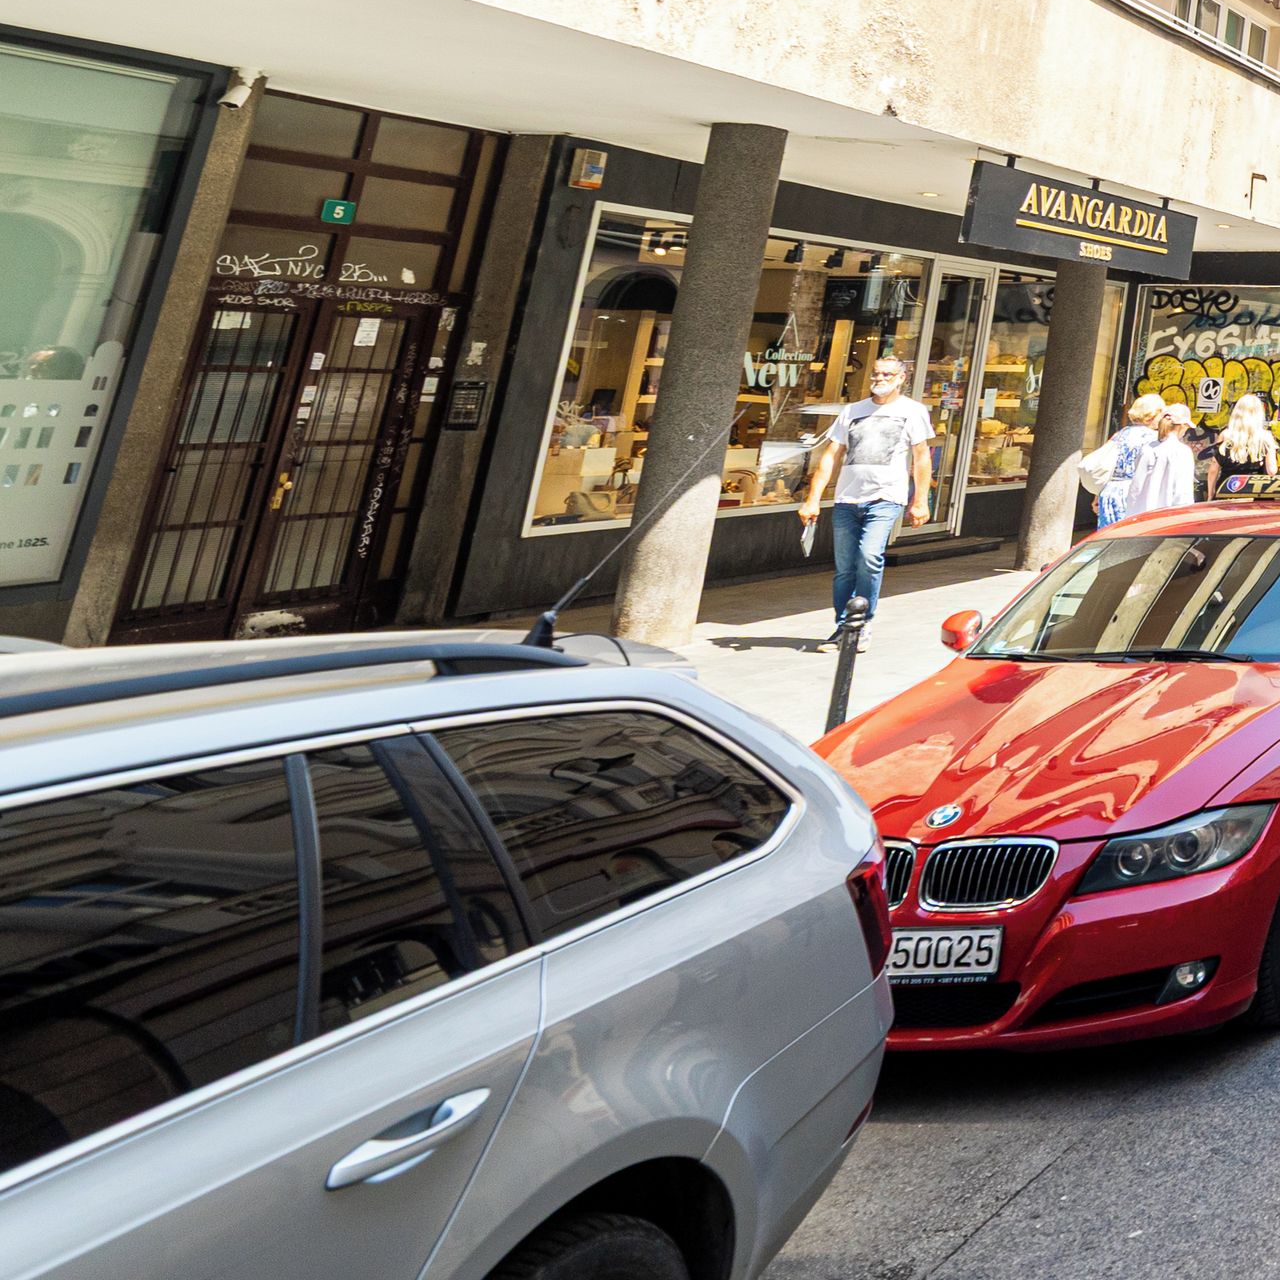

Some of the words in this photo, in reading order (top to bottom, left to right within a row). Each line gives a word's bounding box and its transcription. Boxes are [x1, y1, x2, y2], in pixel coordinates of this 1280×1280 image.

[333, 206, 345, 219] 5
[1019, 182, 1168, 243] AVANGARDIA
[1079, 242, 1112, 261] SHOES
[765, 348, 816, 362] Collection
[744, 351, 805, 388] New
[885, 933, 997, 970] 50025
